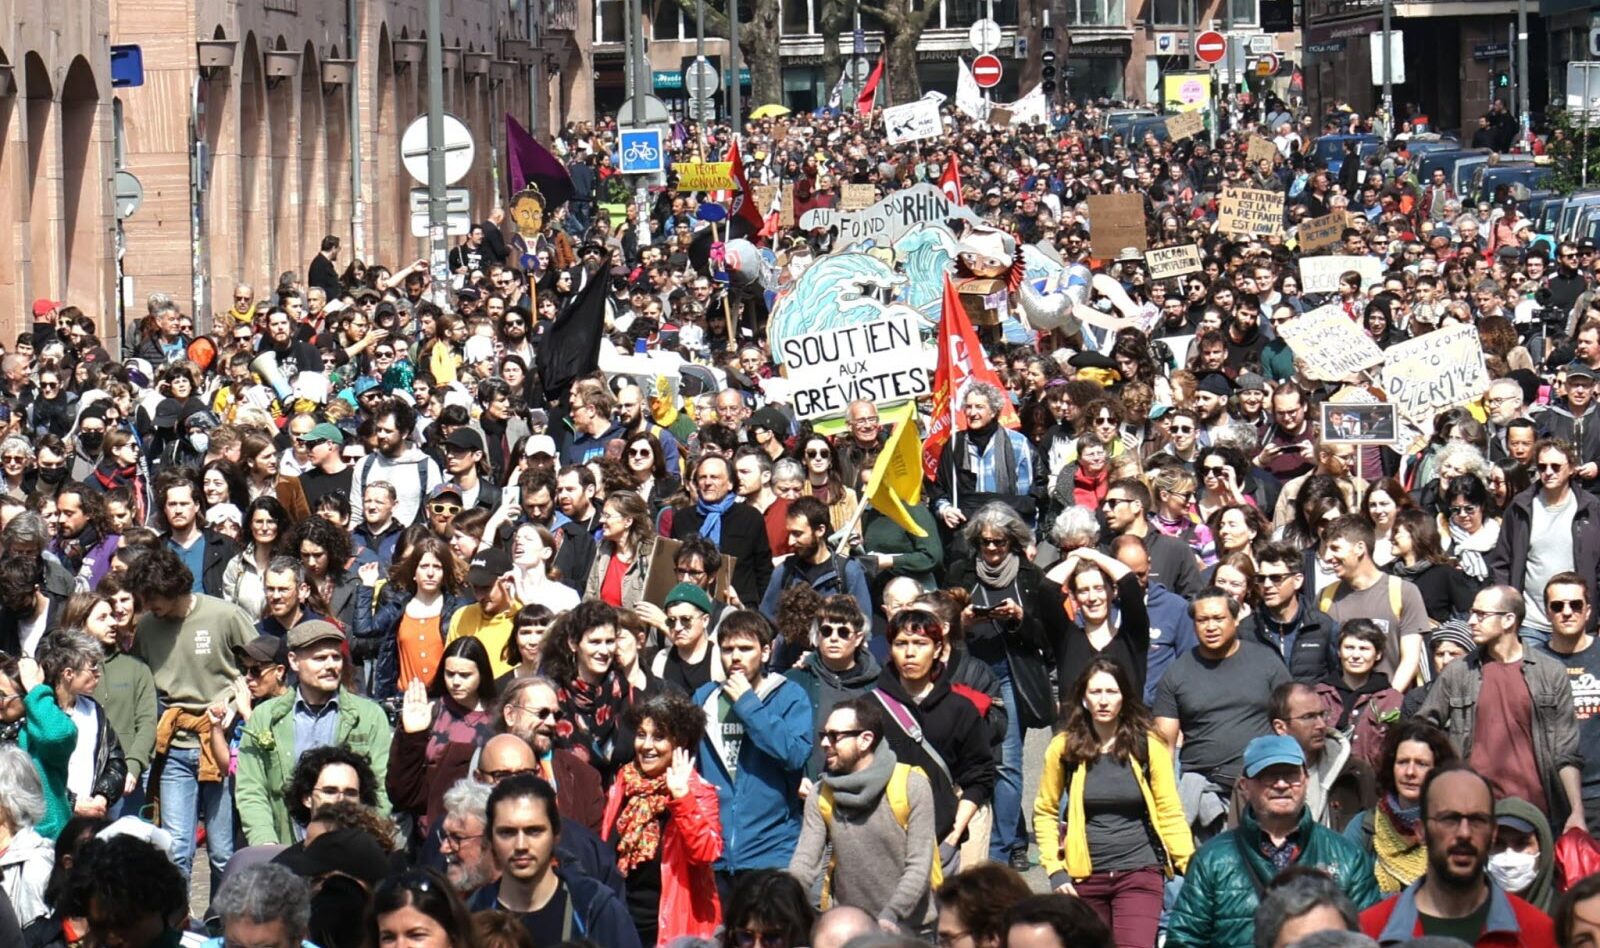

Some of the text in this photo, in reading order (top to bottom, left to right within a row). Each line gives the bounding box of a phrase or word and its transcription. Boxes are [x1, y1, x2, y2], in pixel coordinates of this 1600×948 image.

[1226, 190, 1284, 207] LA DICTATURE
[1238, 200, 1253, 209] EST
[812, 208, 831, 226] AU
[840, 217, 885, 238] FOND
[884, 201, 903, 215] DU
[1223, 206, 1282, 222] LA RETRAITE
[1232, 219, 1250, 229] EST
[1252, 222, 1273, 233] LOIN
[1153, 247, 1189, 262] MACRON
[839, 360, 868, 377] AUX
